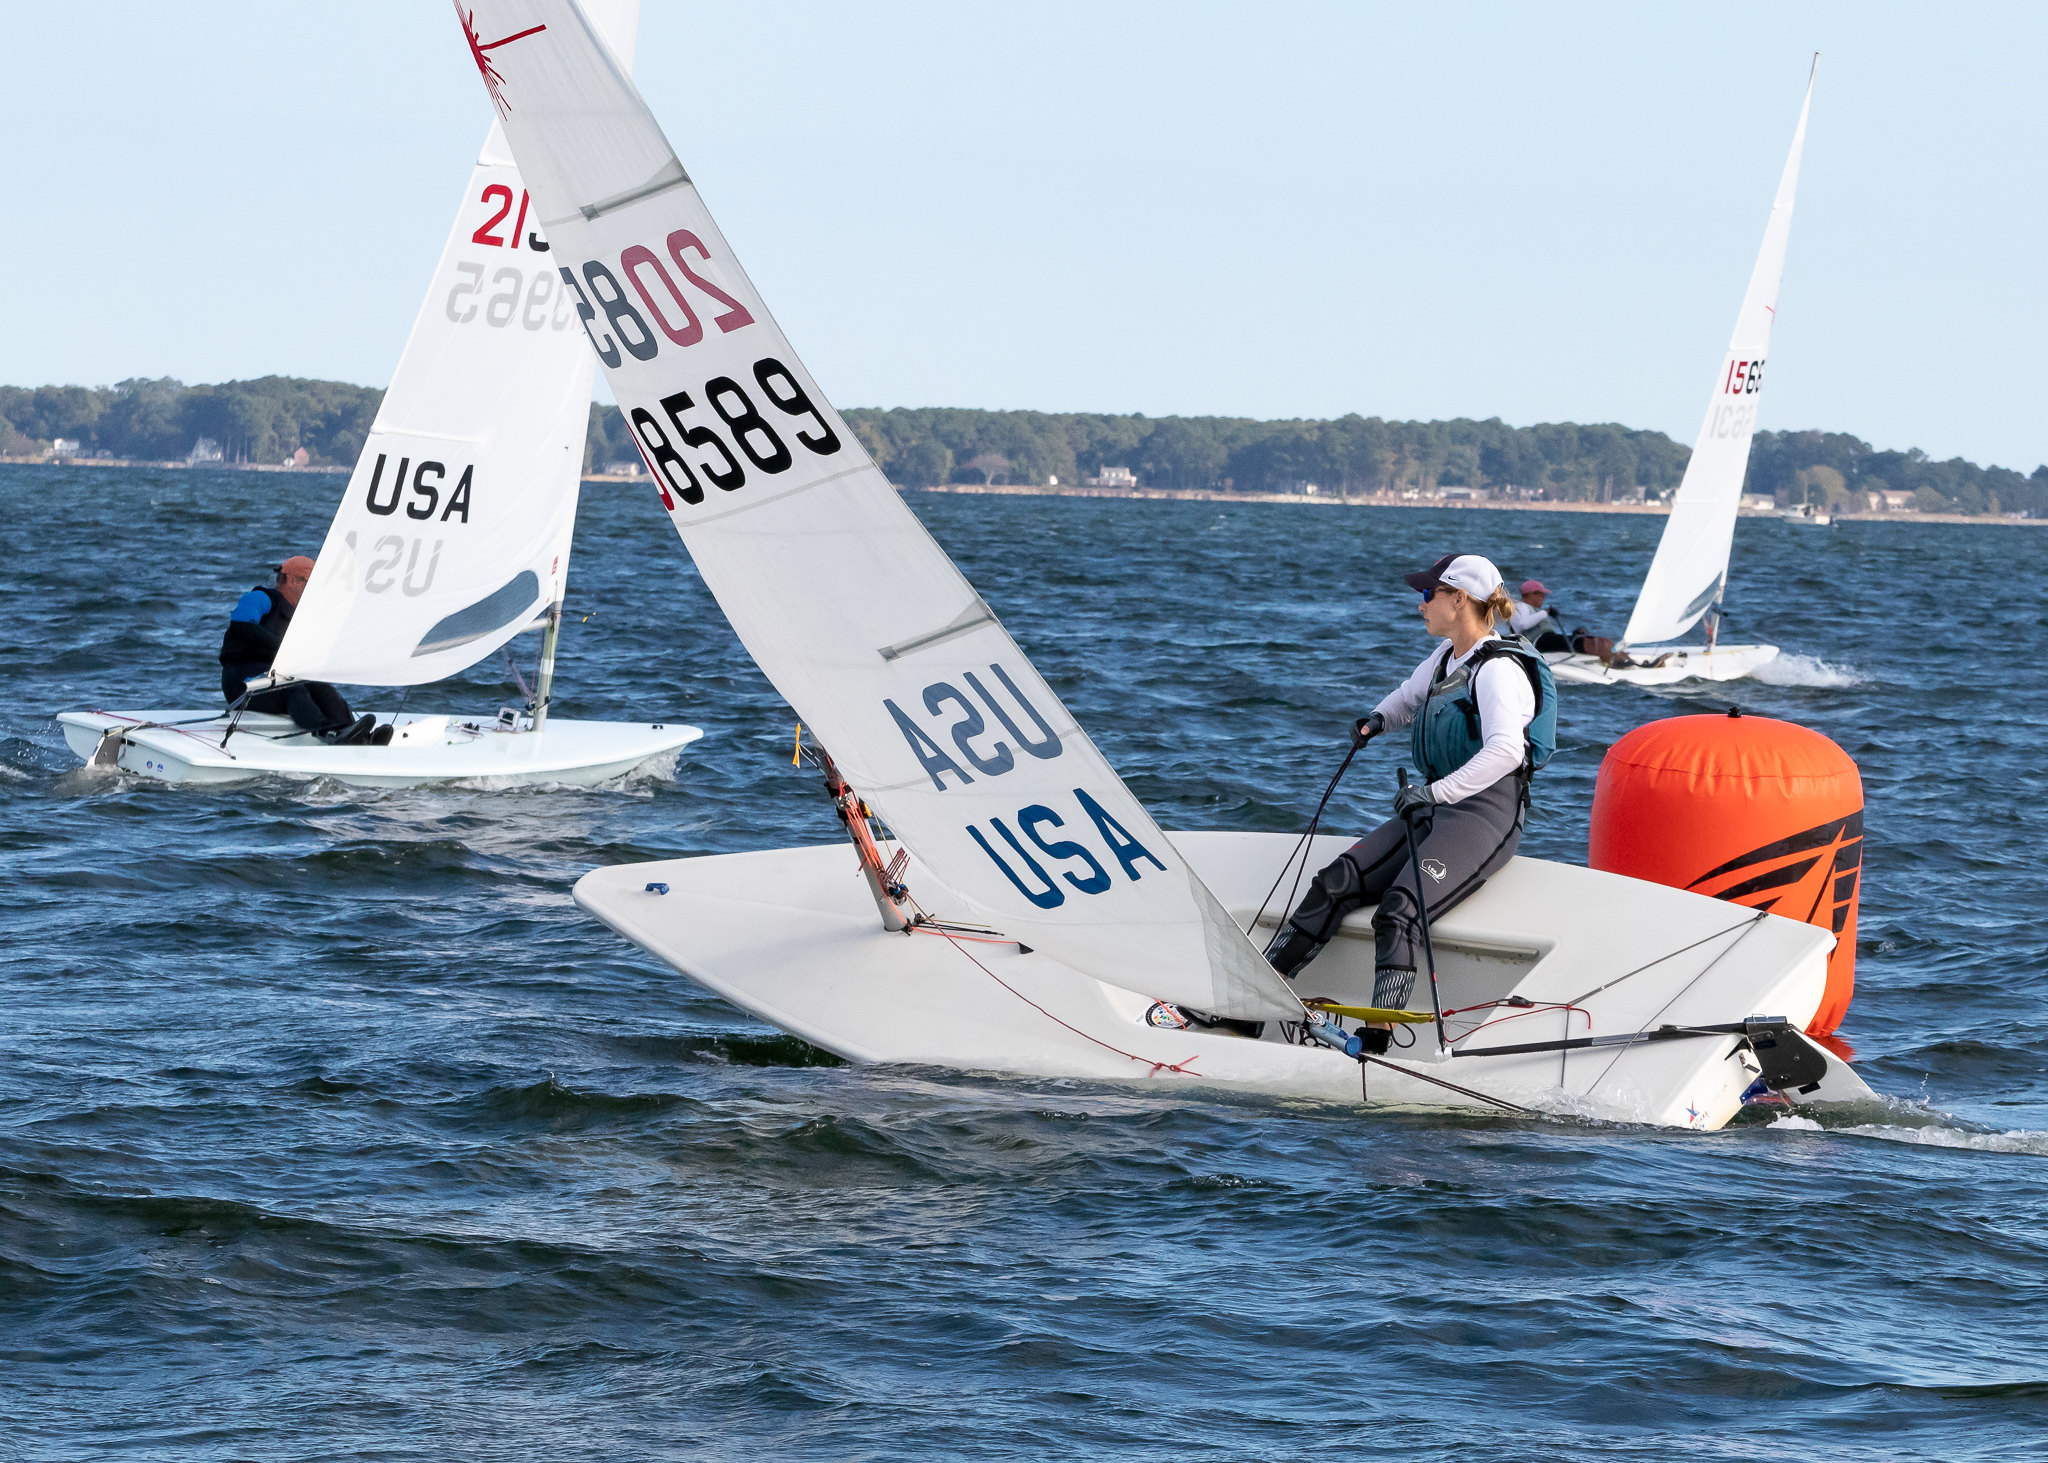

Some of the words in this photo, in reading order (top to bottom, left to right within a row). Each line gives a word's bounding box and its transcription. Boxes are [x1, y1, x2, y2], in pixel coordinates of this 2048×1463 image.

[366, 453, 474, 524] USA
[625, 357, 842, 511] 8589
[965, 787, 1168, 910] USA
